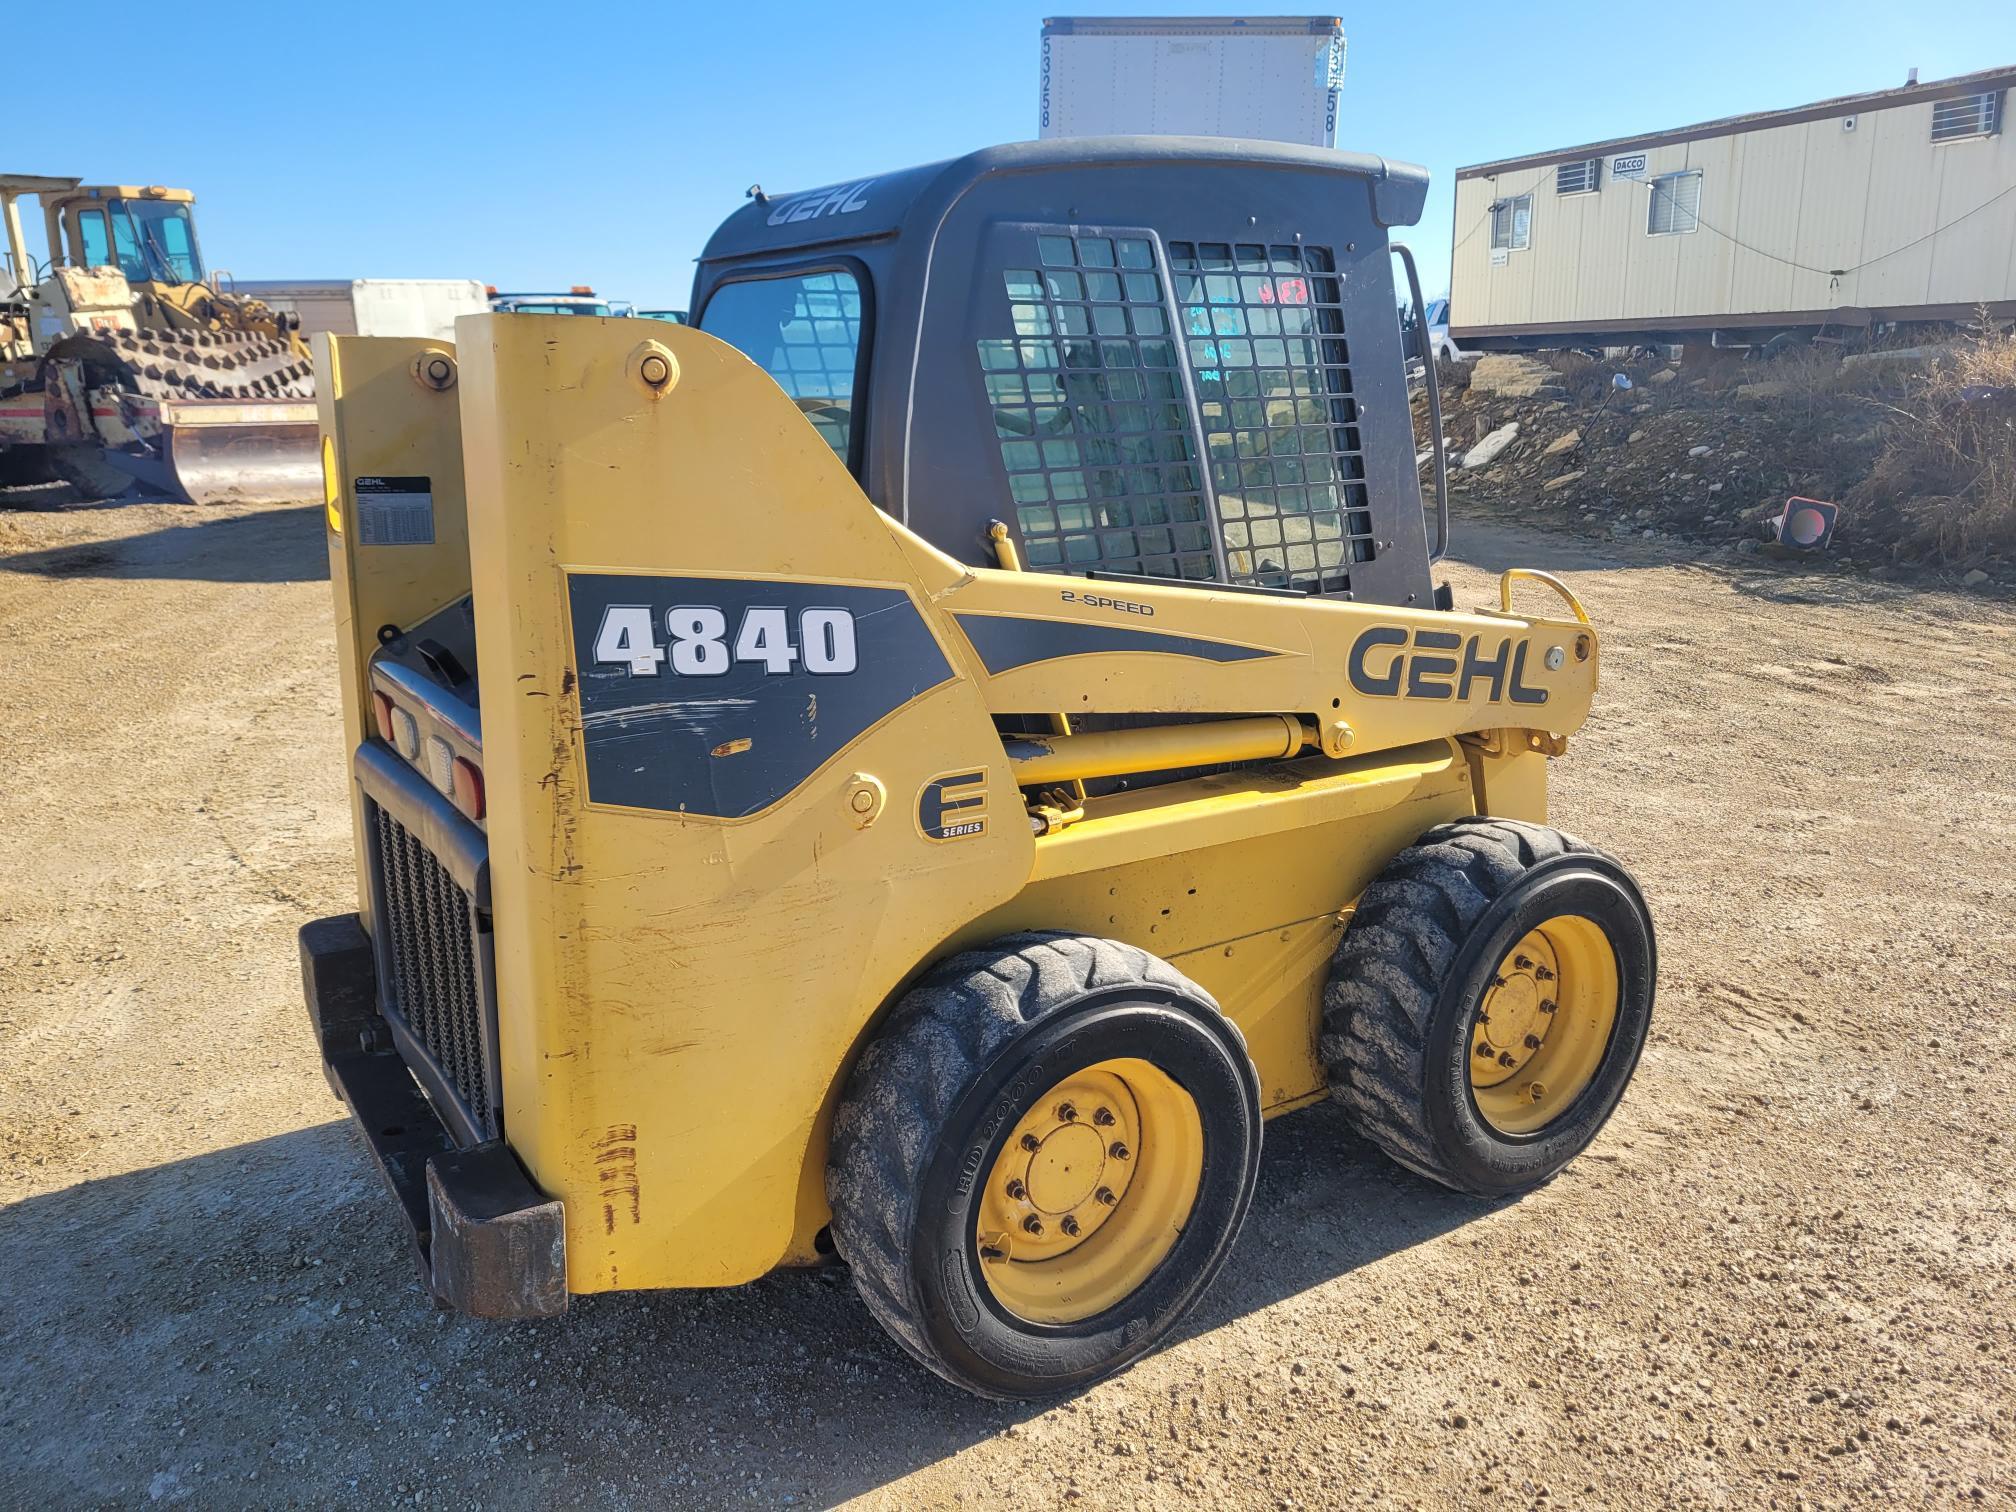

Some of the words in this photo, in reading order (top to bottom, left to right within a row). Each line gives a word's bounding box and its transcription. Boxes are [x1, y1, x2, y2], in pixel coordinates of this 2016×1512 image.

[1042, 37, 1051, 127] 53258
[1616, 159, 1643, 170] DACCO
[767, 179, 876, 226] GEHL
[356, 478, 385, 486] GEHL
[1061, 590, 1154, 616] 2-SPEED
[593, 604, 859, 678] 4840
[1348, 627, 1549, 705] GEHL
[918, 771, 984, 840] E
[942, 822, 981, 838] SERIES
